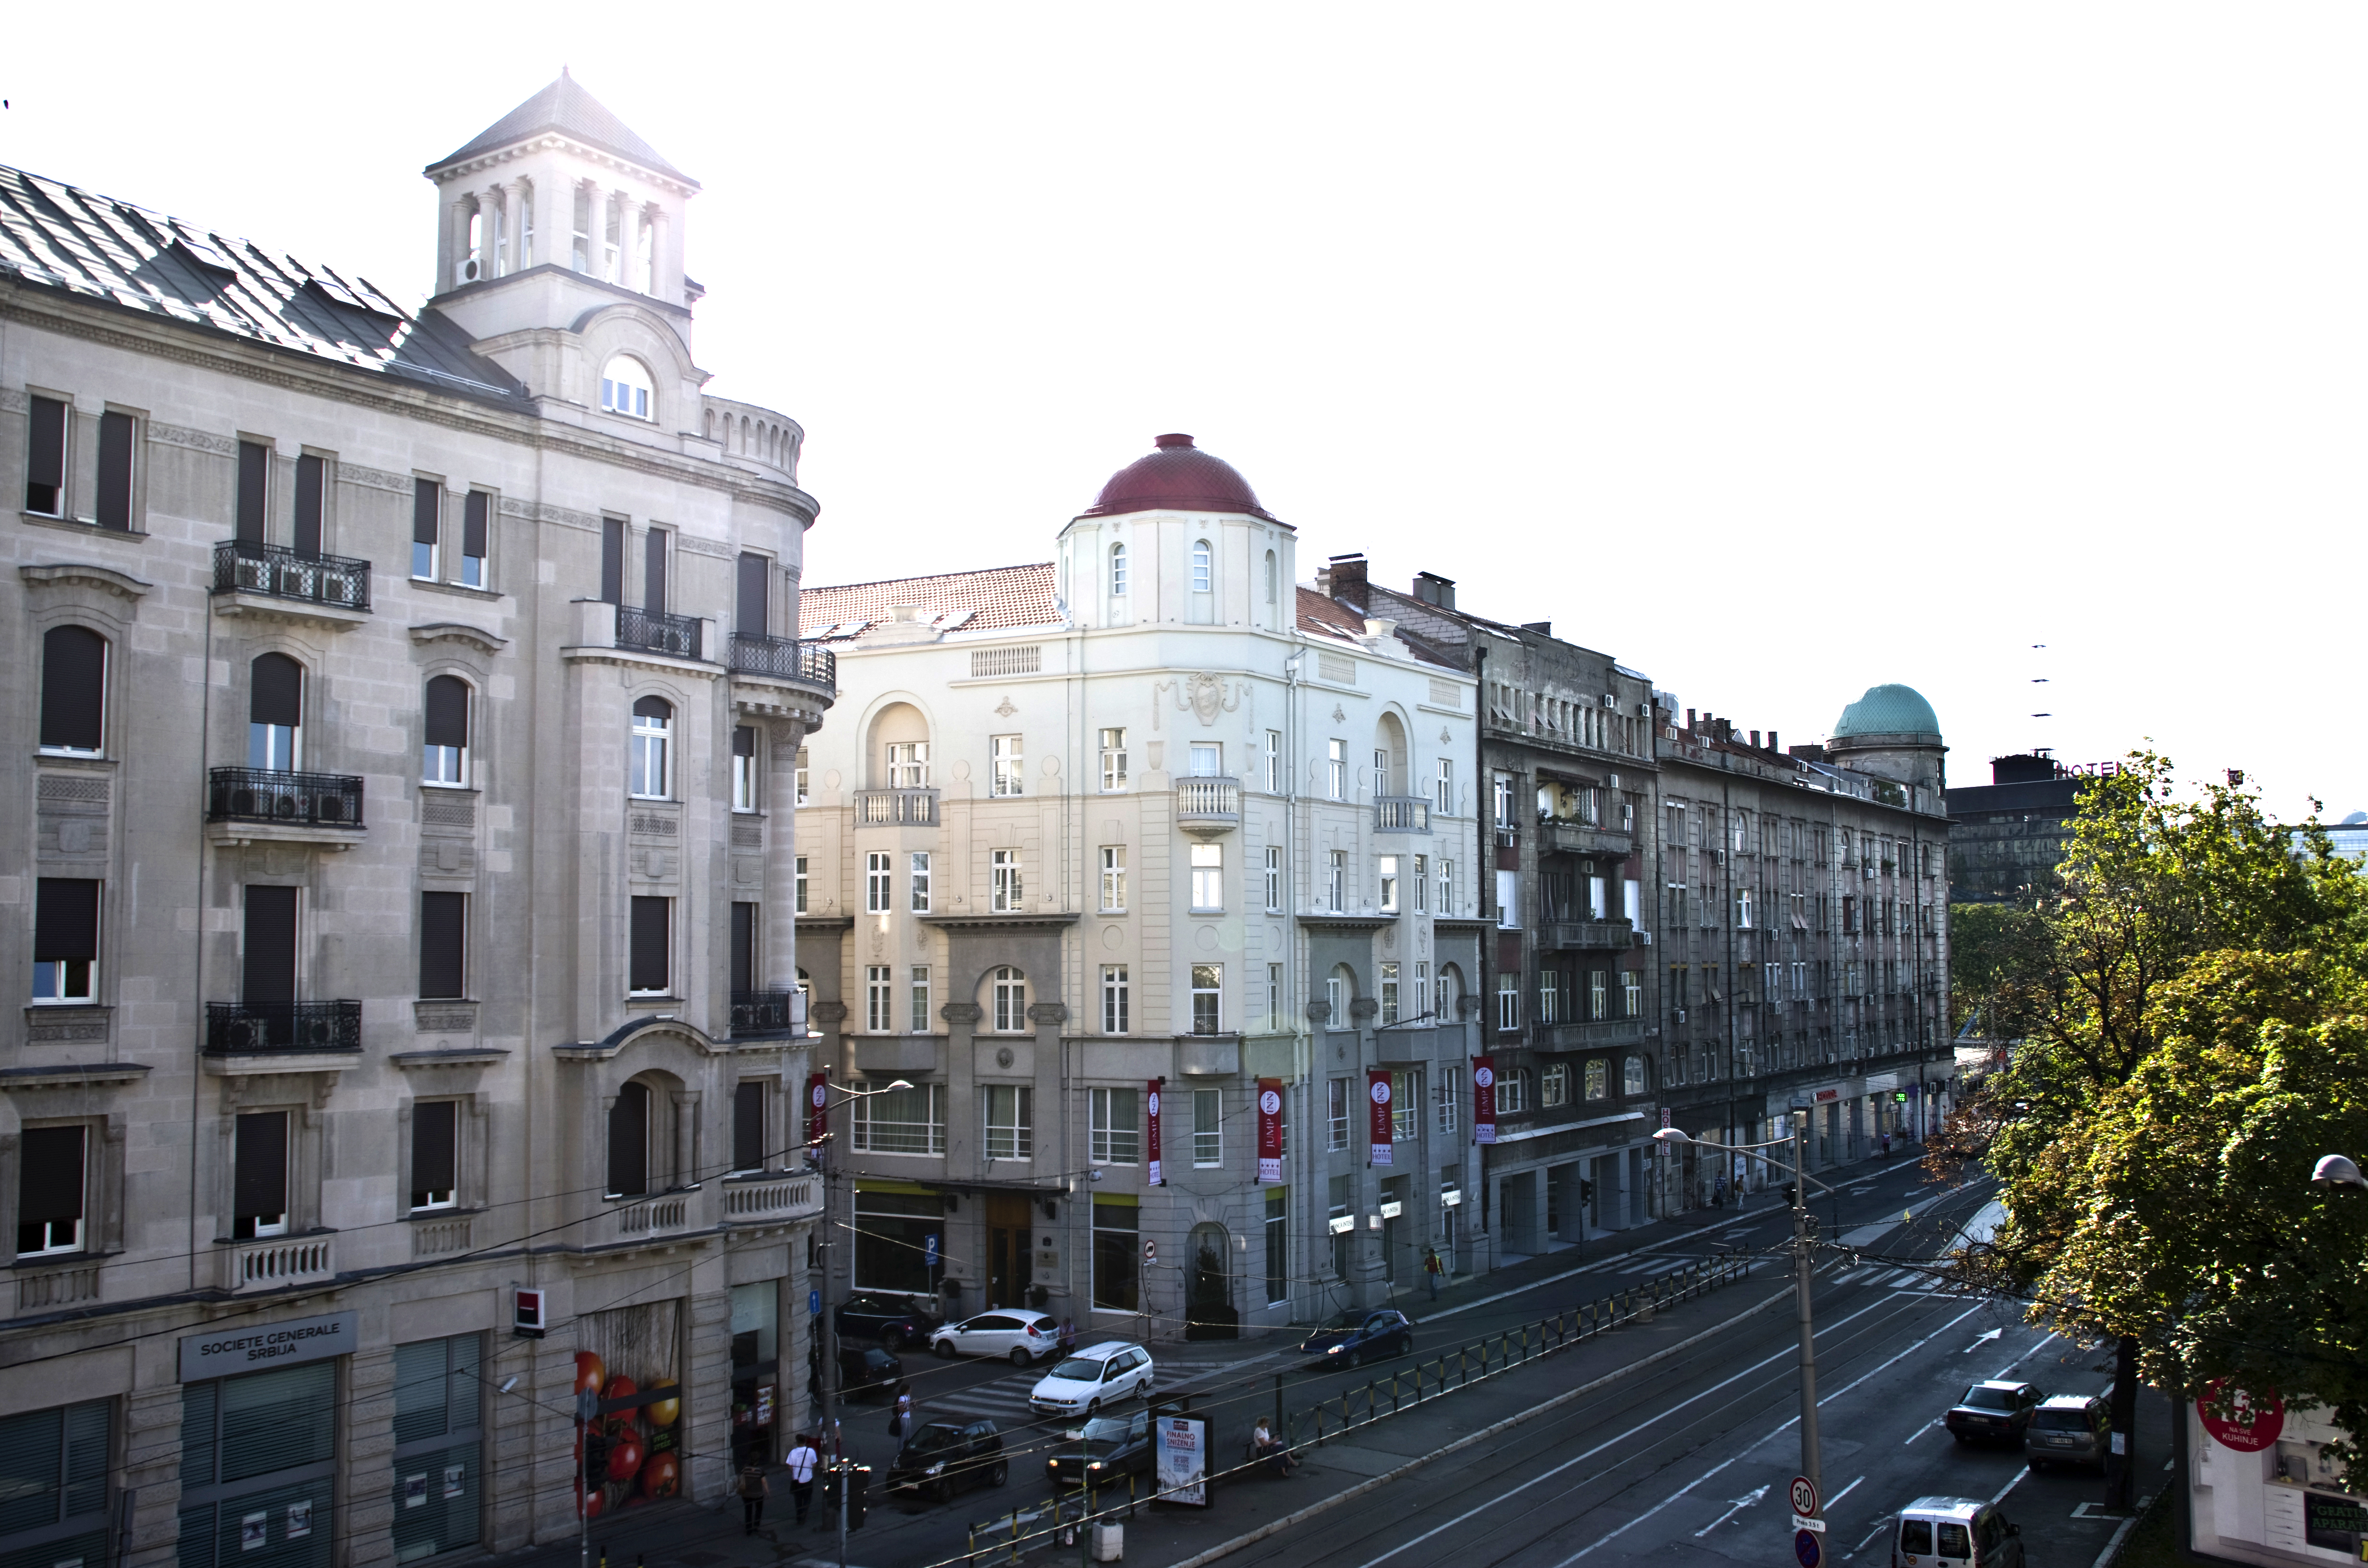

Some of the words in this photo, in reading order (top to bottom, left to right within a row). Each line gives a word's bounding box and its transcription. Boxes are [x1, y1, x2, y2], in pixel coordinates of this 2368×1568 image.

[1481, 1090, 1489, 1115] JUMP
[1378, 1107, 1386, 1134] JUMP
[1266, 1118, 1275, 1147] JUMP
[928, 1238, 935, 1252] P
[201, 1336, 263, 1355] SOCIETE
[268, 1323, 340, 1344] GENERALE
[247, 1343, 296, 1360] SRBIJA
[1167, 1431, 1195, 1440] FINALNO
[1167, 1439, 1195, 1447] SNIŽENJE
[2222, 1433, 2258, 1446] KUHINJE
[1795, 1486, 1810, 1508] 30
